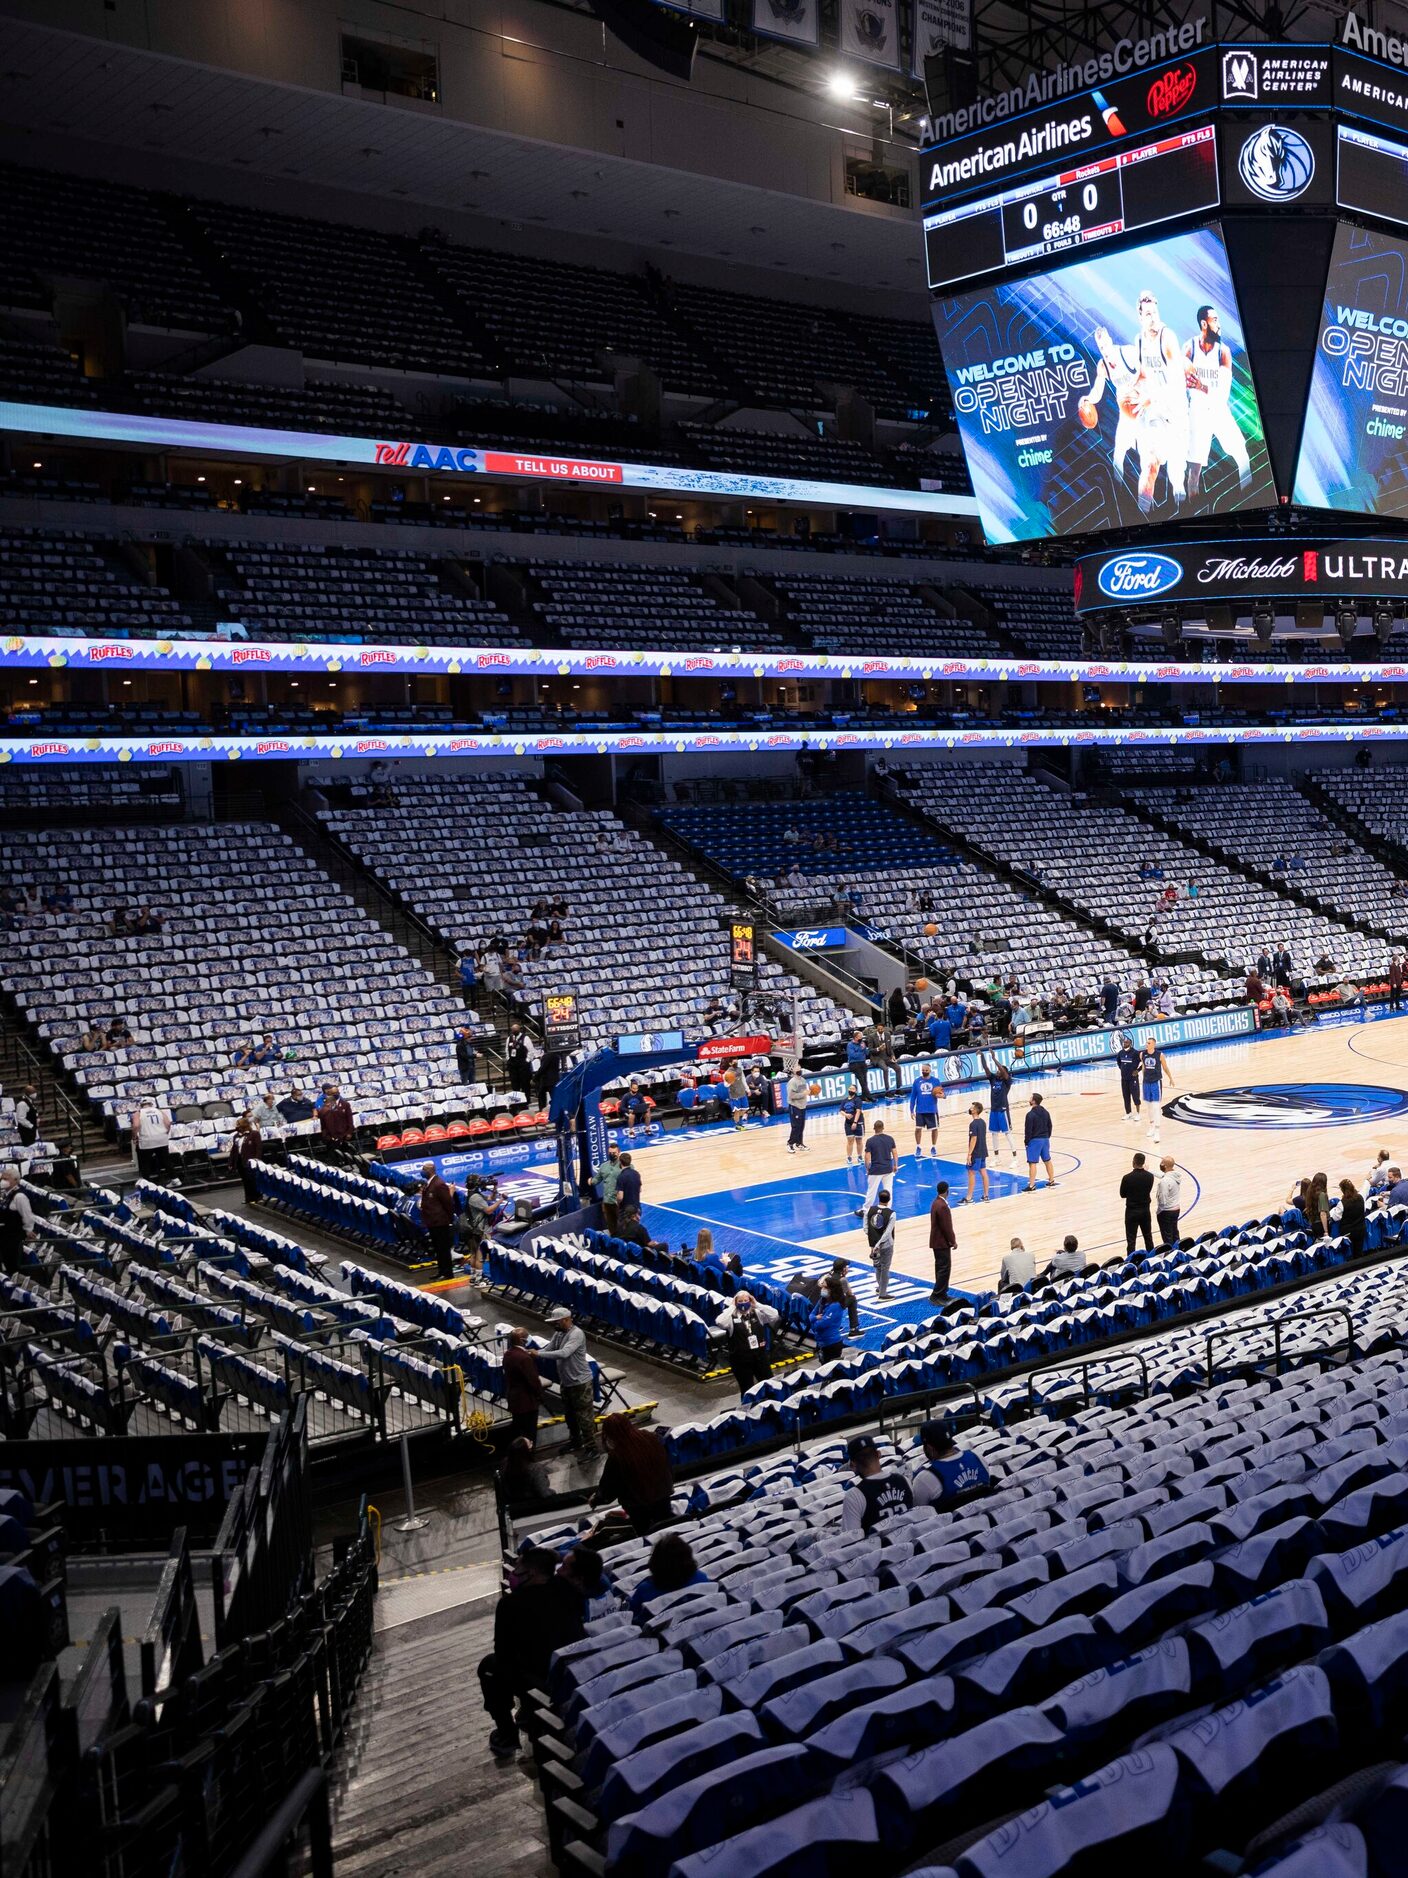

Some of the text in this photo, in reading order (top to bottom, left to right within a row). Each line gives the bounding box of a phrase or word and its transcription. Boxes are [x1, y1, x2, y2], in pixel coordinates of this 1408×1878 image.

[921, 11, 967, 36] CHAMPIONS
[1262, 59, 1328, 70] AMERICAN
[1163, 69, 1182, 91] Dr
[1262, 70, 1322, 81] AIRLINES
[1148, 72, 1193, 118] Pepper
[1131, 130, 1211, 162] PLAYER PTS FLS
[1075, 164, 1101, 180] Rockets
[1052, 190, 1067, 201] QTR
[1083, 184, 1098, 211] 0
[1023, 203, 1038, 230] 0
[1043, 215, 1081, 240] 66:48
[1084, 226, 1113, 241] TIMEOUTS
[1053, 237, 1072, 249] FOULS
[956, 343, 1075, 385] WELCOME TO
[954, 360, 1091, 413] OPENING
[980, 391, 1069, 434] NIGHT
[1371, 403, 1400, 417] PRESENTED
[1366, 416, 1406, 440] chime
[374, 442, 616, 480] Tell AAC TELL US ABOUT
[1017, 448, 1053, 469] chime
[1110, 561, 1160, 592] Ford
[1197, 555, 1299, 583] Michelob
[89, 644, 134, 661] RUFFLES
[584, 655, 617, 669] RUFFLES
[1087, 666, 1110, 677] RUFFLES
[963, 733, 981, 742] RUFFLES
[1362, 728, 1383, 737] RUFFLES
[31, 743, 69, 756] RUFFLES
[450, 739, 479, 751] RUFFLES
[732, 925, 753, 940] 66:48
[792, 930, 827, 949] Ford
[547, 996, 574, 1010] 66:48
[552, 1008, 570, 1022] 24
[556, 1024, 579, 1032] TISSOT
[1138, 1024, 1181, 1047] DALLAS
[1184, 1012, 1250, 1039] MAVERICKS
[588, 1115, 600, 1167] CHOCTAW
[441, 1144, 530, 1166] GEICO GEICO
